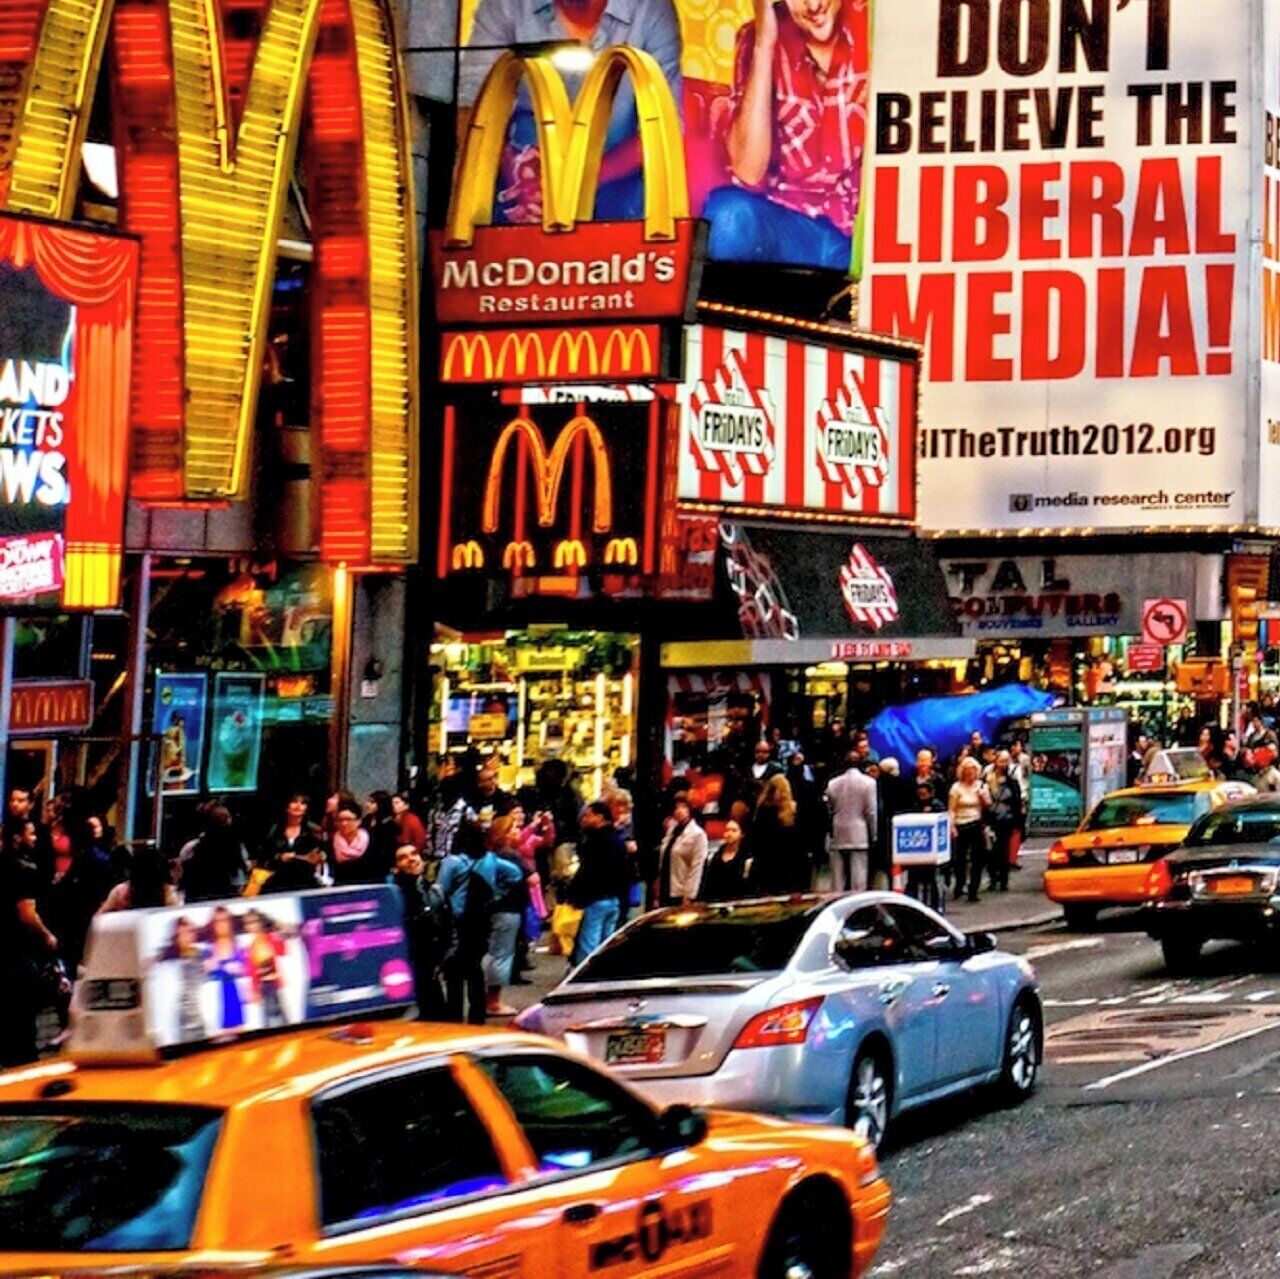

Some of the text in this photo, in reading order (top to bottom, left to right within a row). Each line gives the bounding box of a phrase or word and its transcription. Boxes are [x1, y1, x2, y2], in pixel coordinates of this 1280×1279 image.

[876, 80, 1237, 155] BELIEVE THE
[872, 156, 1236, 263] LIBERAL
[442, 251, 676, 290] McDonald's
[478, 290, 635, 314] Restaurant
[870, 264, 1235, 383] MEDIA!
[0, 407, 64, 448] KETS
[0, 449, 71, 505] WS.
[1034, 490, 1233, 507] media research center
